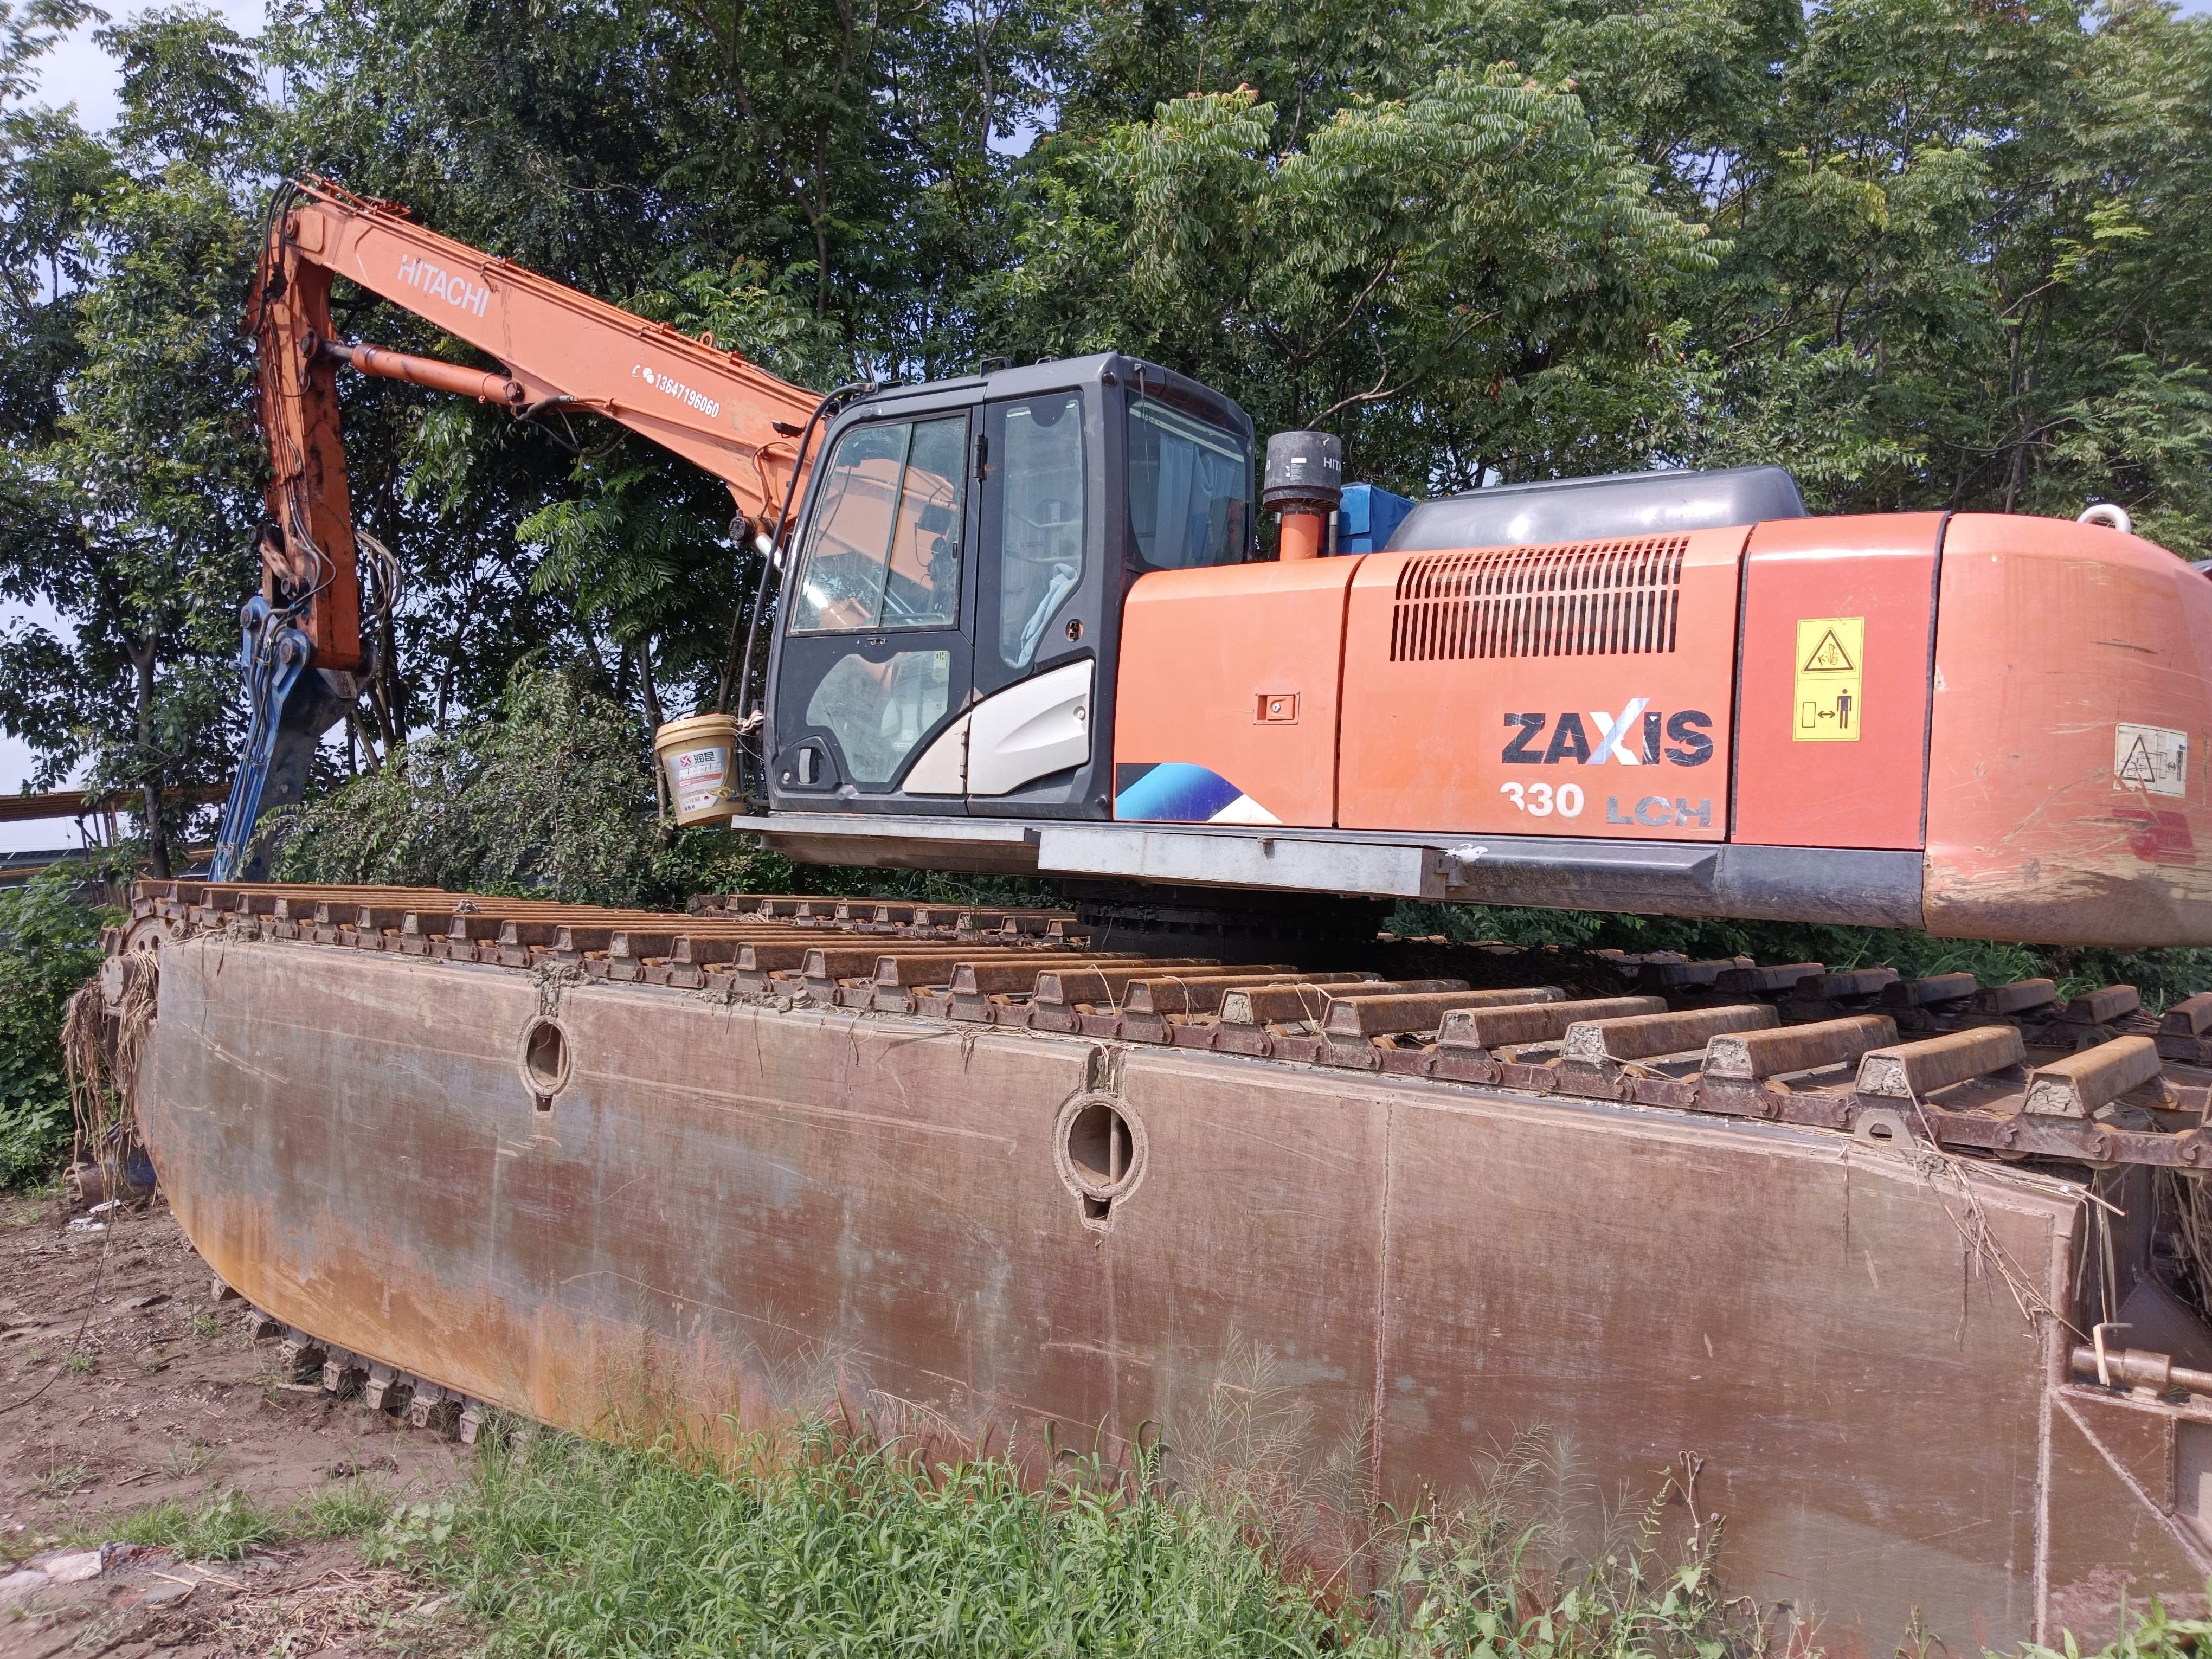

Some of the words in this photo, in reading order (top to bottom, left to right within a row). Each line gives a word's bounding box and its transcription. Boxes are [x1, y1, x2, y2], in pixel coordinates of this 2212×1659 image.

[397, 255, 489, 318] HITACHI
[655, 373, 720, 419] 13647196060
[1501, 698, 1714, 767] ZAXIS
[1500, 781, 1585, 818] 330
[1606, 796, 1712, 827] LCH
